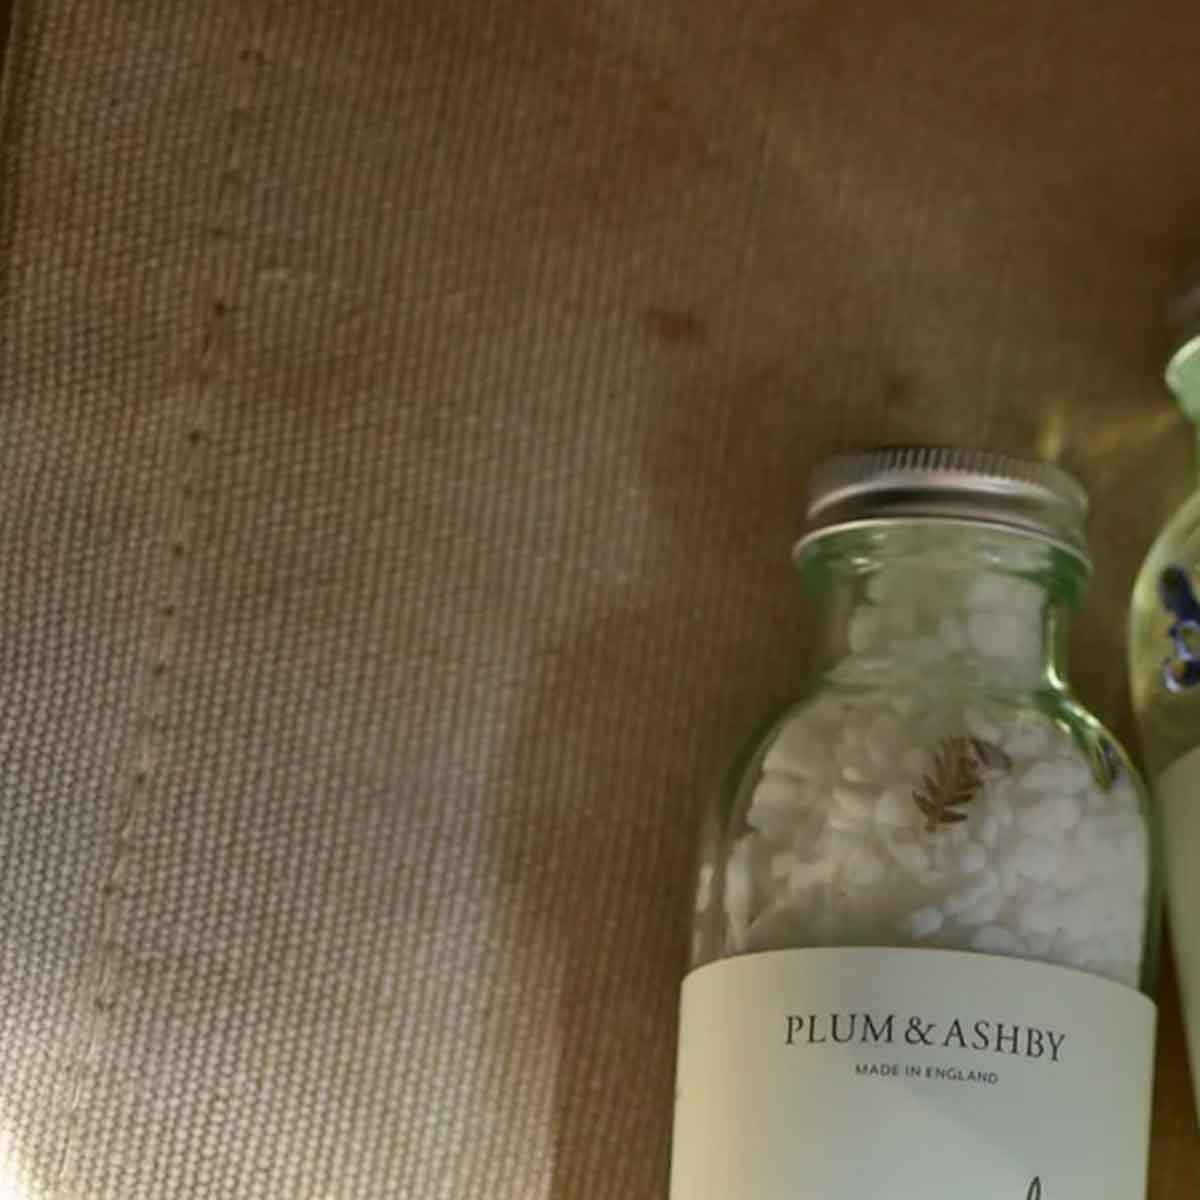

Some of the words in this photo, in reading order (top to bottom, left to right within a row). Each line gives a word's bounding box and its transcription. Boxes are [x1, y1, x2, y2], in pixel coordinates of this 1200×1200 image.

[784, 1013, 895, 1046] PLUM
[904, 1015, 936, 1046] &
[942, 1017, 1066, 1063] ASHBY
[855, 1063, 900, 1078] MADE
[905, 1065, 921, 1078] IN
[925, 1066, 998, 1085] ENGLAND
